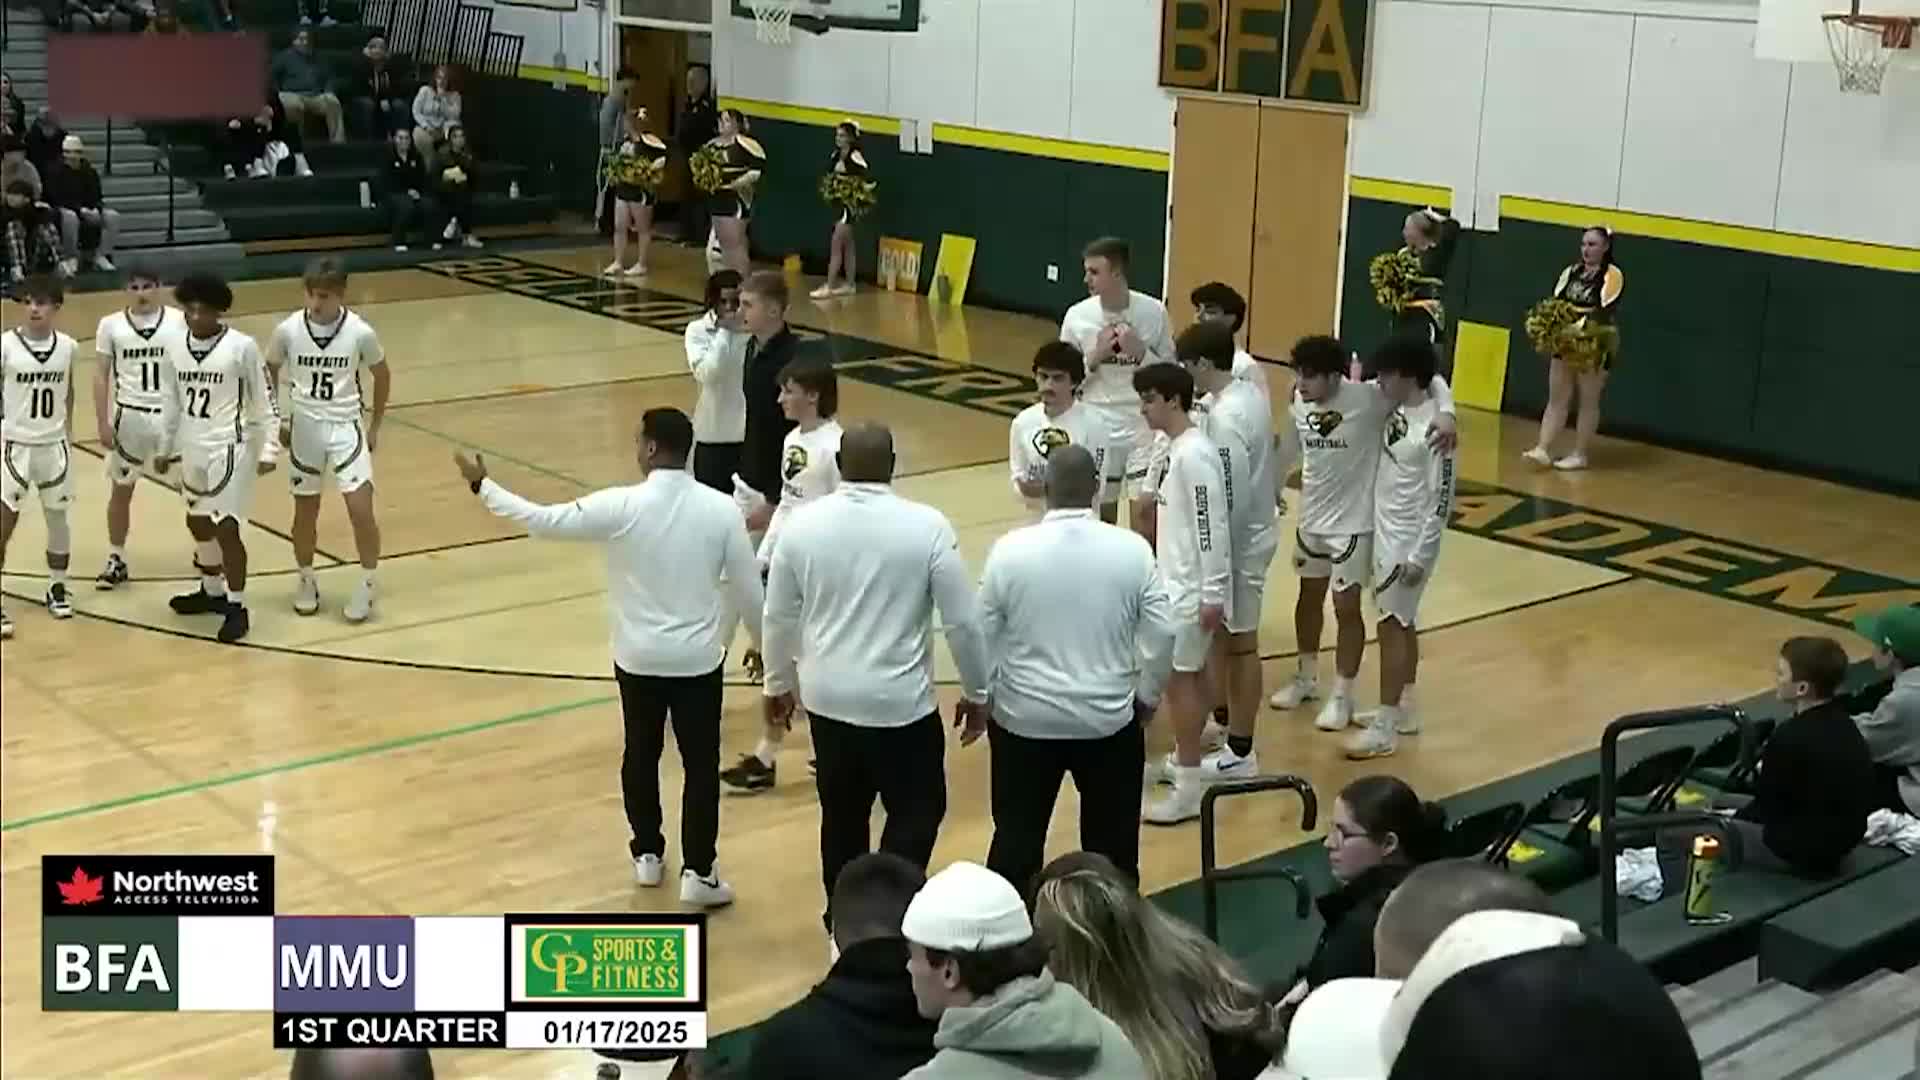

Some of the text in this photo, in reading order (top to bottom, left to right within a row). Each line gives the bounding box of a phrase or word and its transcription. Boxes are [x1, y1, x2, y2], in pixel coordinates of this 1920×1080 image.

[1165, 0, 1361, 104] BFA
[141, 362, 160, 391] 11
[310, 372, 333, 400] 15
[30, 388, 54, 418] 10
[186, 387, 212, 418] 22
